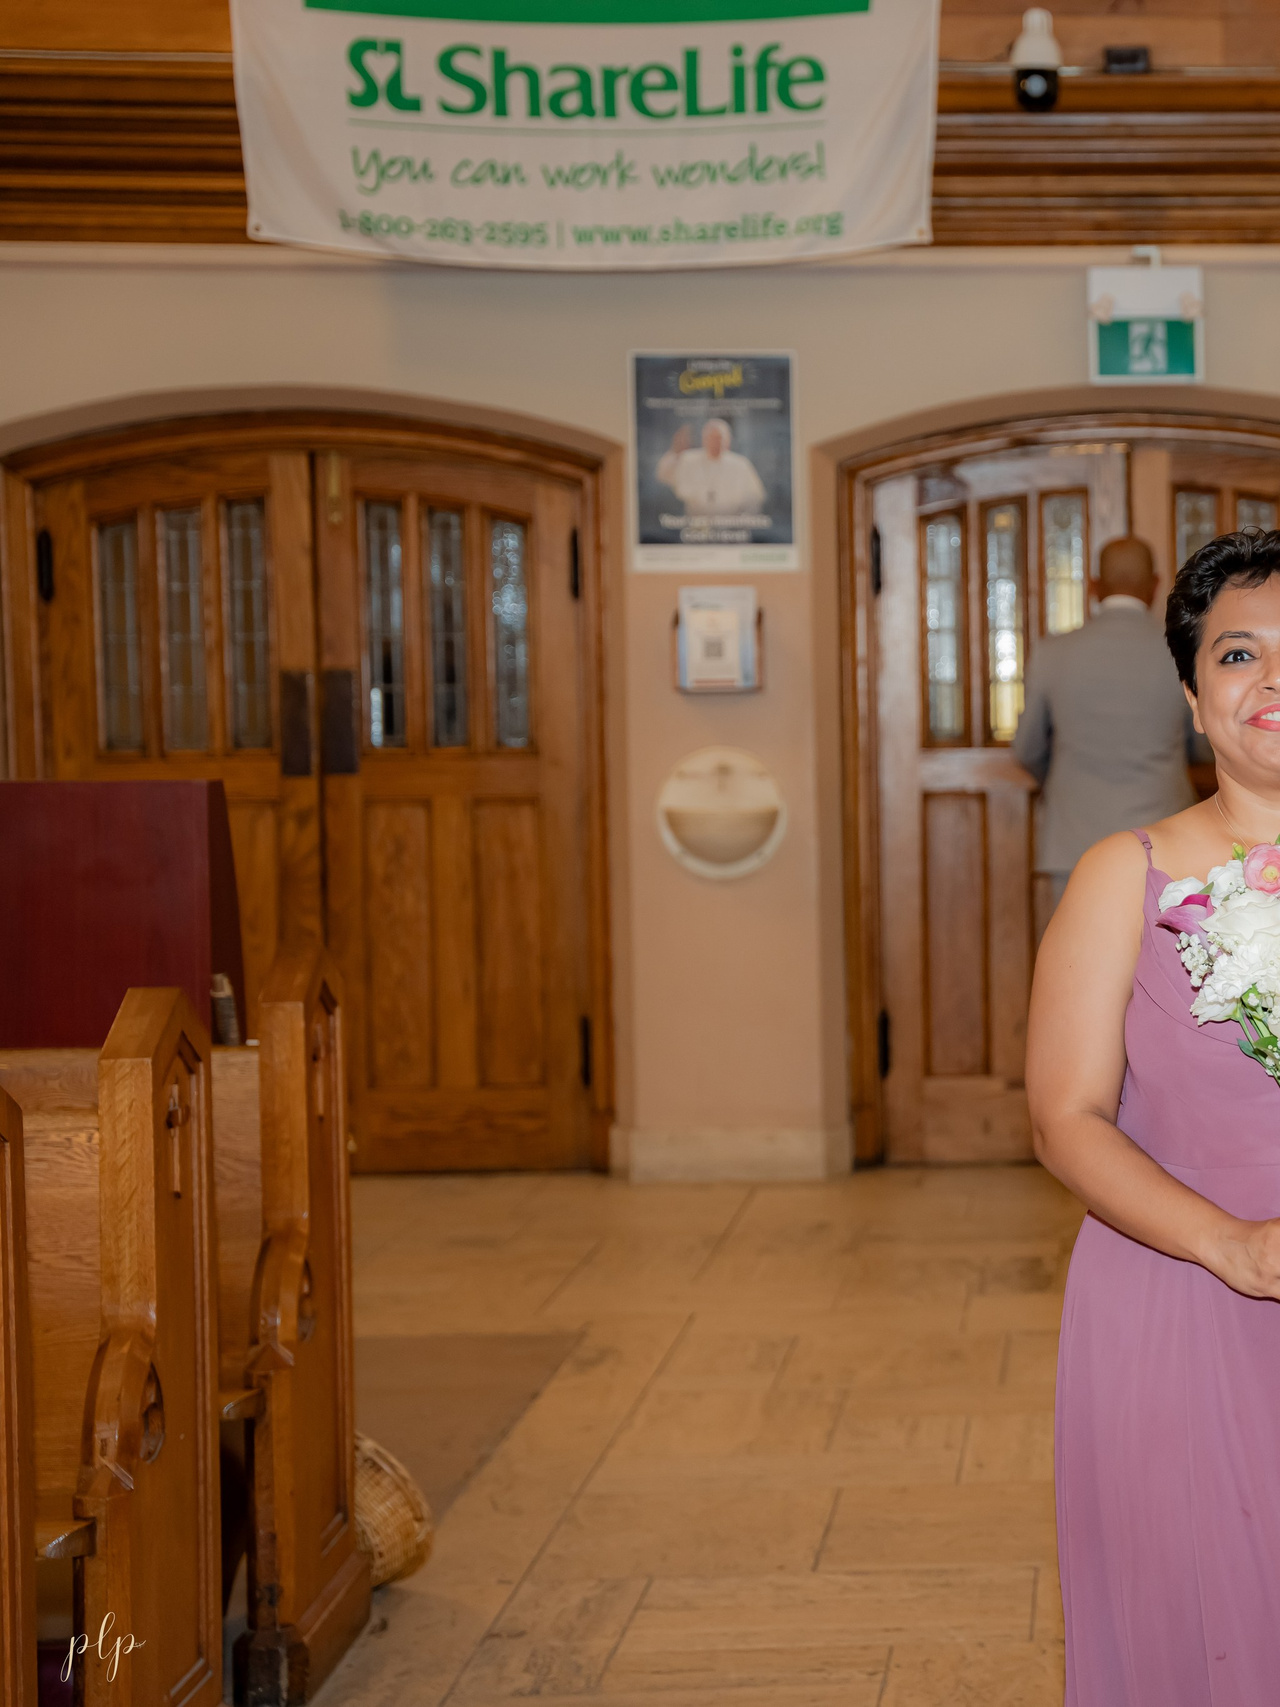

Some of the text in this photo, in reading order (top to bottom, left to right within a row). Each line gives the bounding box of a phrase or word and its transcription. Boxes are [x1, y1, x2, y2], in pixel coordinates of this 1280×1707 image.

[437, 42, 826, 120] ShareLife
[351, 140, 827, 196] You can work wonders!
[571, 211, 845, 246] www.sharelife.org
